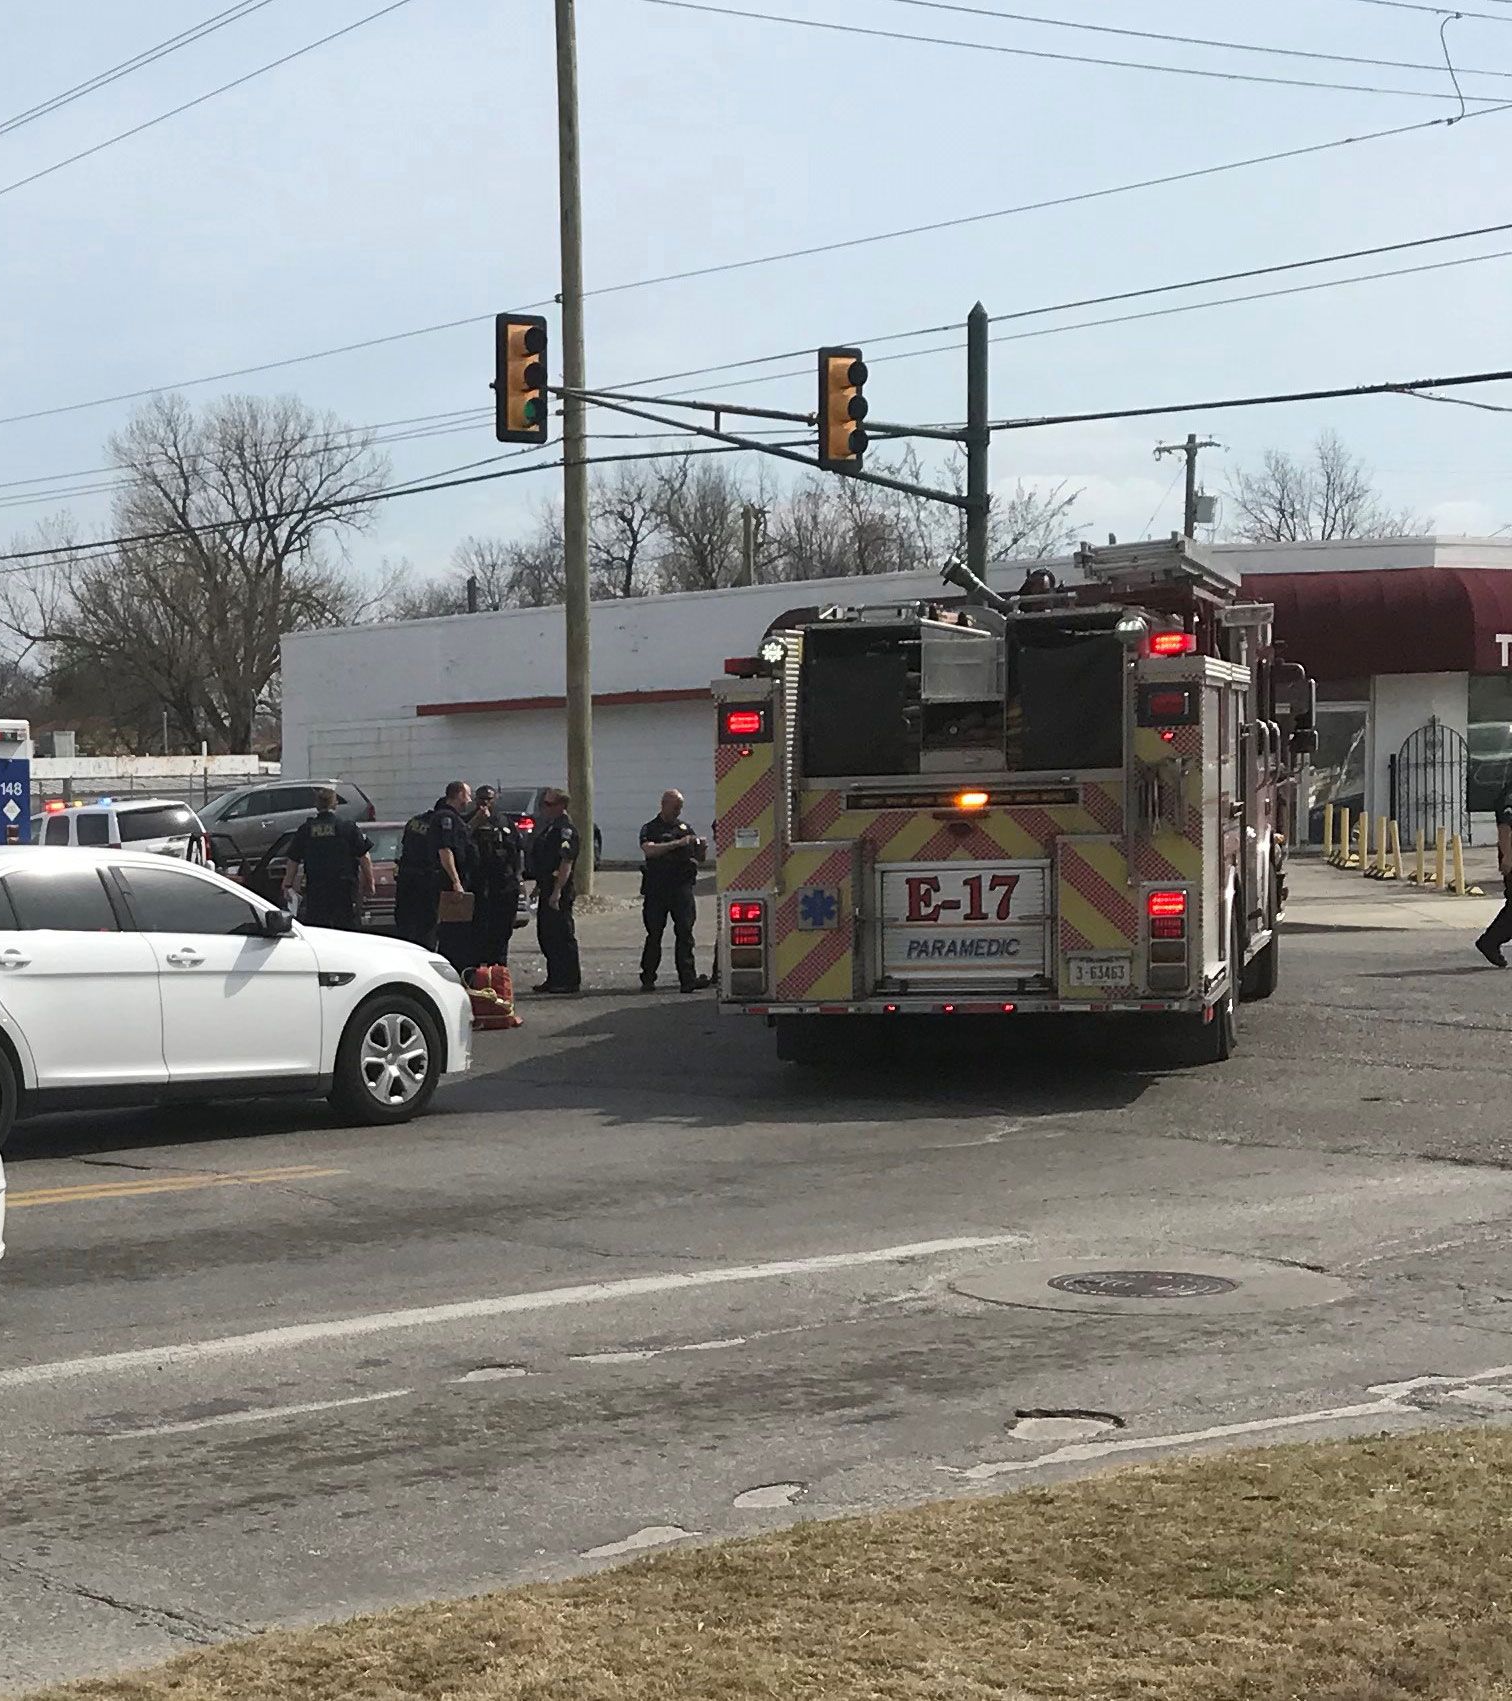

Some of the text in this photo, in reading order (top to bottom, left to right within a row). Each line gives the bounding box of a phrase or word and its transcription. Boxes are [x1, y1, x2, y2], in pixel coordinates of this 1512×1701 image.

[0, 782, 23, 796] 148
[905, 874, 1021, 922] E-17
[906, 938, 1021, 960] PARAMEDIC
